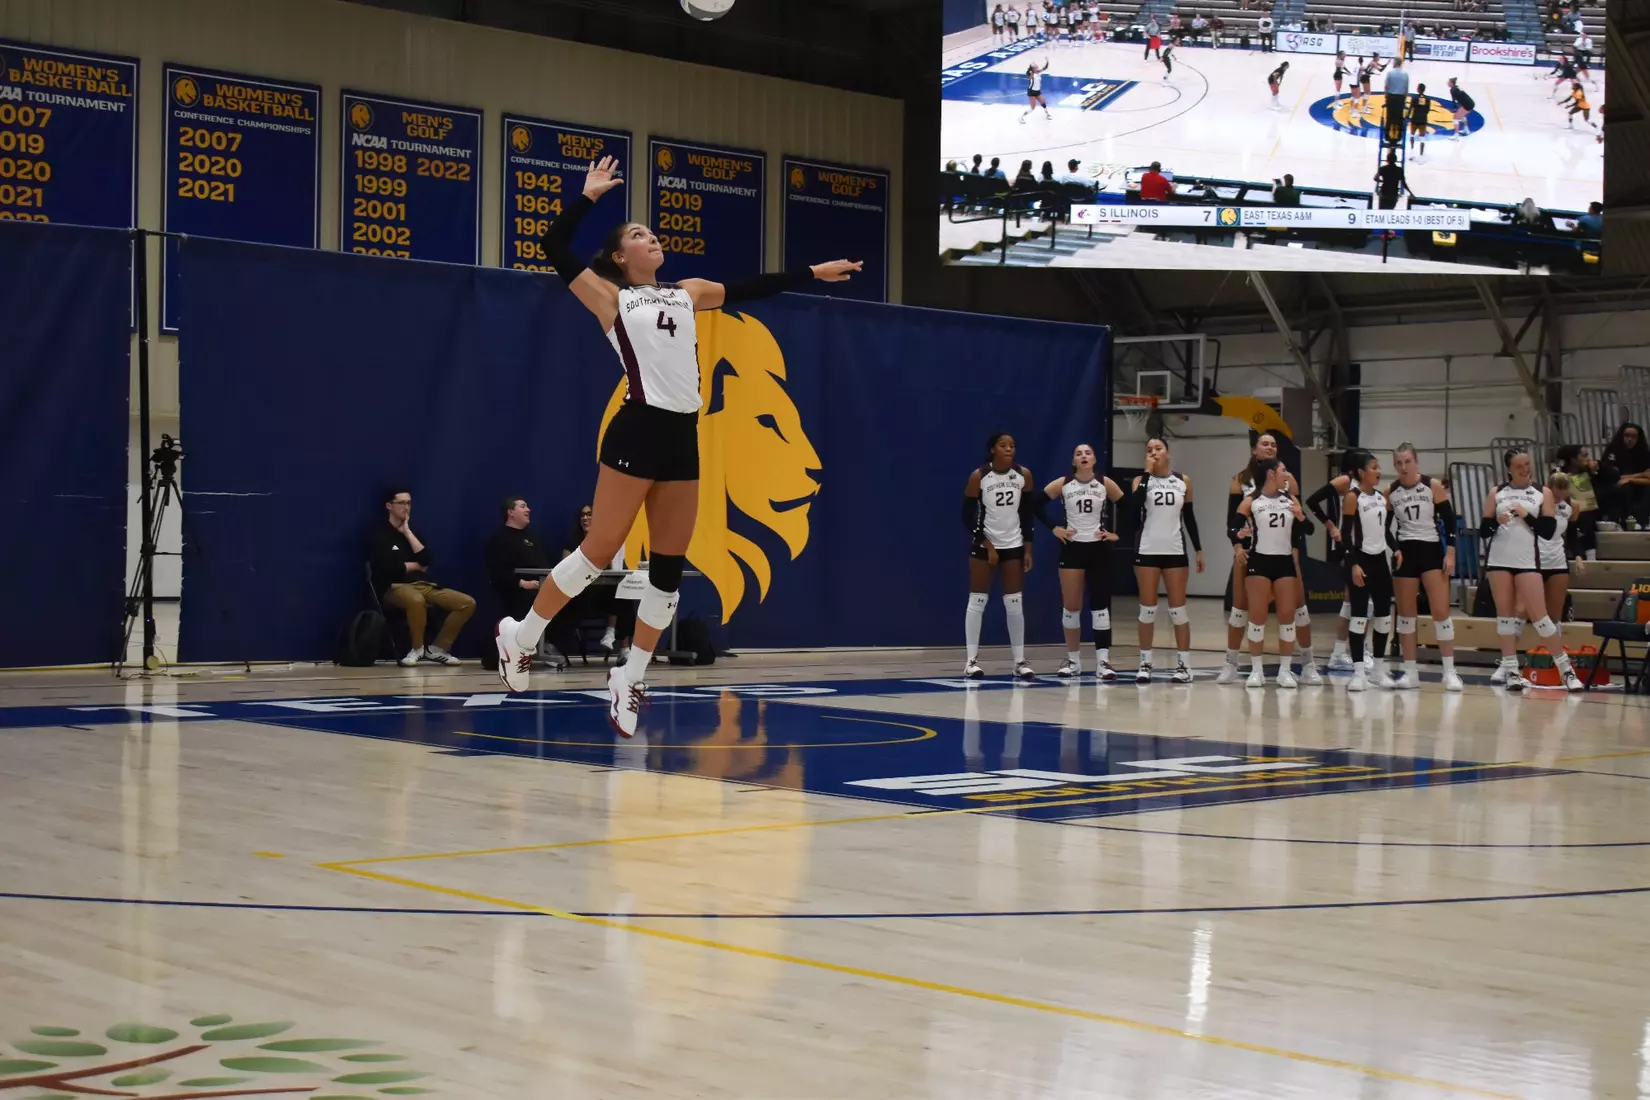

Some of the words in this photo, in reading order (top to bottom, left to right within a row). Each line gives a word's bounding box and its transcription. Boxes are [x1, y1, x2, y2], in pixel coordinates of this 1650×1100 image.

[1432, 44, 1447, 52] BEST
[1471, 45, 1534, 58] Brookshire's
[23, 57, 120, 82] WOMEN'S
[8, 68, 132, 97] BASKETBALL
[0, 85, 22, 101] AA
[26, 90, 126, 112] TOURNAMENT
[216, 83, 303, 107] WOMEN'S
[0, 103, 52, 128] 007
[203, 94, 314, 121] BASKETBALL
[174, 110, 234, 125] CONFERENCE
[237, 119, 311, 135] CHAMPIONSHIPS
[402, 111, 454, 130] MEN'S
[0, 130, 45, 154] 019
[179, 126, 242, 152] 2007
[406, 124, 448, 141] GOLF
[557, 132, 604, 151] MEN'S
[352, 132, 387, 149] NCAA
[391, 139, 472, 158] TOURNAMENT
[562, 144, 599, 160] GOLF
[0, 157, 51, 182] 020
[179, 152, 242, 178] 2020
[354, 149, 407, 173] 1998
[417, 158, 471, 181] 2022
[510, 155, 560, 169] CONFERENCE
[563, 163, 623, 177] CHAMPPS
[687, 153, 752, 172] WOMEN'S
[515, 170, 562, 193] 1942
[702, 166, 736, 181] GOLF
[818, 171, 877, 189] WOMEN'S
[0, 184, 43, 207] 021
[178, 177, 235, 203] 2021
[355, 174, 408, 197] 1999
[657, 175, 687, 190] NCAA
[690, 181, 757, 197] TOURNAMENT
[831, 183, 863, 197] GOLF
[353, 197, 406, 221] 2001
[514, 193, 563, 216] 1964
[659, 190, 703, 212] 2019
[789, 193, 830, 206] CONFERENCE
[659, 212, 702, 233] 2021
[1099, 208, 1107, 218] S
[1110, 208, 1158, 219] ILLINOIS
[1203, 210, 1211, 222] 7
[1244, 210, 1264, 220] EAST
[1267, 210, 1291, 221] TEXAS
[1294, 211, 1312, 221] A&M
[1348, 213, 1356, 224] 9
[1365, 215, 1385, 225] ETAM
[1387, 215, 1410, 225] LEADS
[1412, 216, 1422, 225] 1-0
[1424, 216, 1445, 226] (BEST
[1447, 217, 1457, 225] OF
[352, 221, 411, 246] 2002
[514, 216, 553, 237] 196
[513, 239, 547, 260] 199
[659, 233, 705, 255] 2022
[657, 311, 677, 337] 4
[995, 490, 1014, 507] 22
[1076, 498, 1092, 514] 18
[1154, 491, 1175, 506] 20
[1269, 512, 1285, 528] 21
[1377, 510, 1383, 526] 1
[1404, 504, 1420, 520] 17
[1630, 583, 1650, 594] LIO
